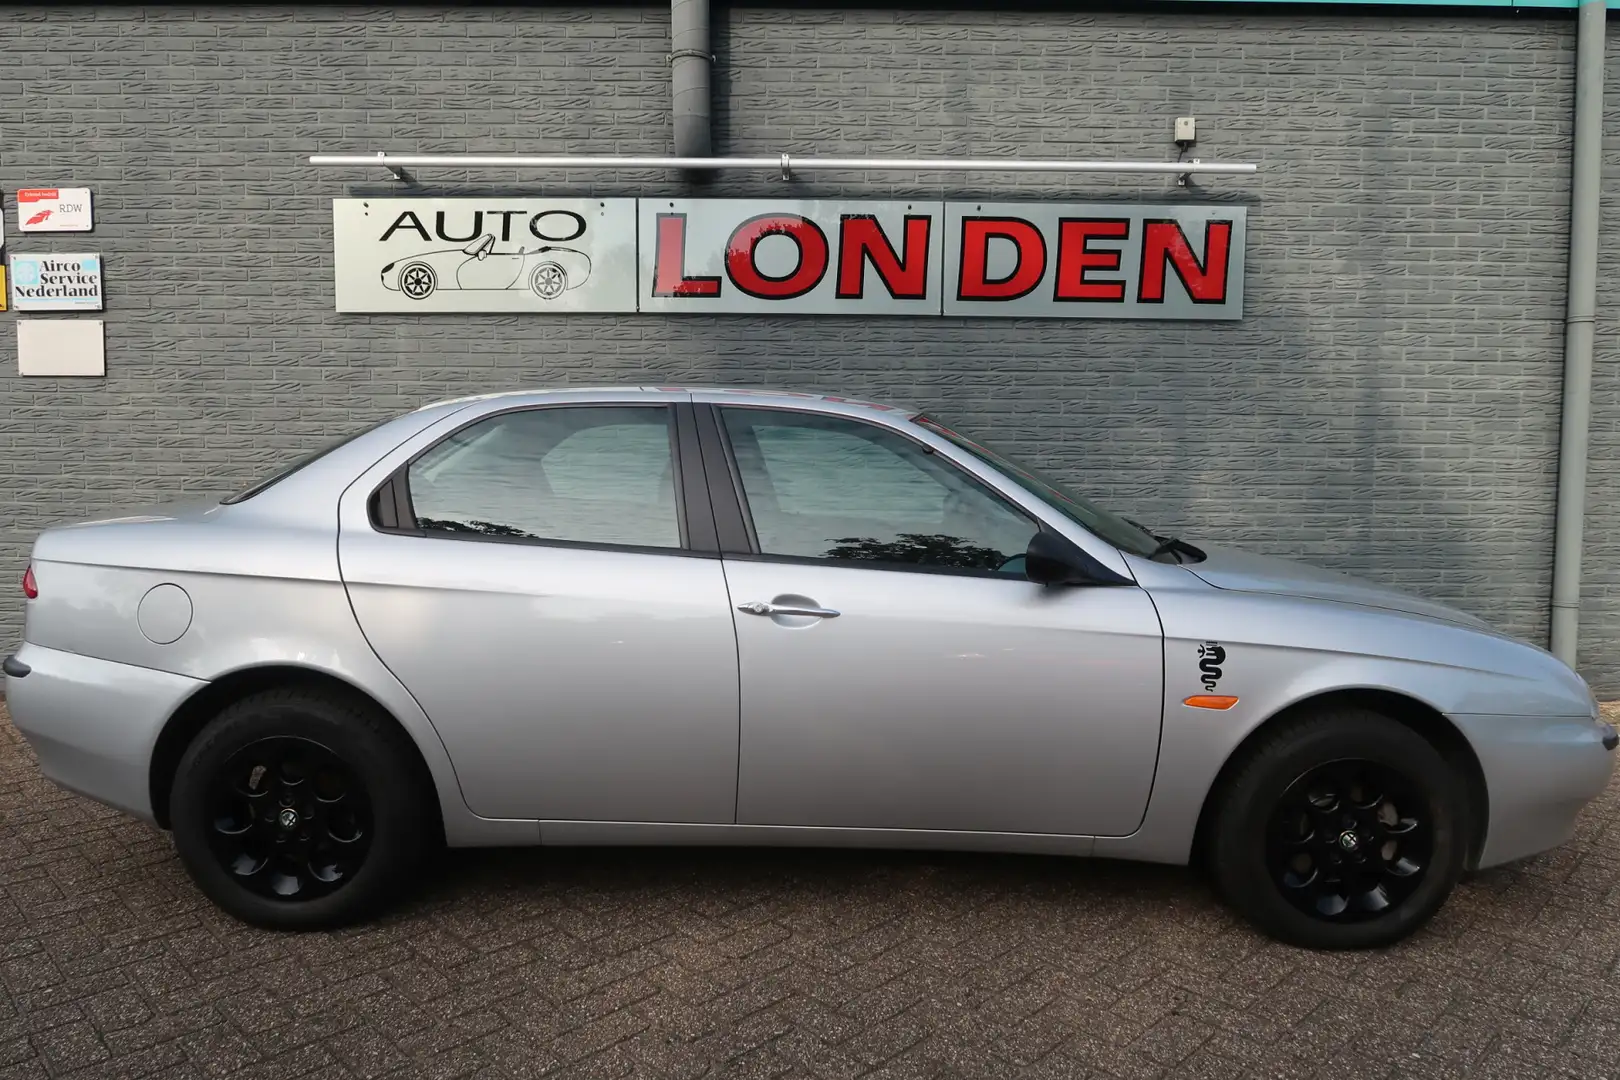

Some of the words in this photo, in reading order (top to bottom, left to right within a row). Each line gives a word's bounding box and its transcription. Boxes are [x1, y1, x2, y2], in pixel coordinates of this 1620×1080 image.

[59, 204, 83, 213] RDW
[379, 210, 587, 242] AUTO
[652, 212, 1233, 305] LONDEN
[40, 260, 81, 272] Airco
[40, 272, 98, 285] Service
[15, 285, 98, 298] Nederland
